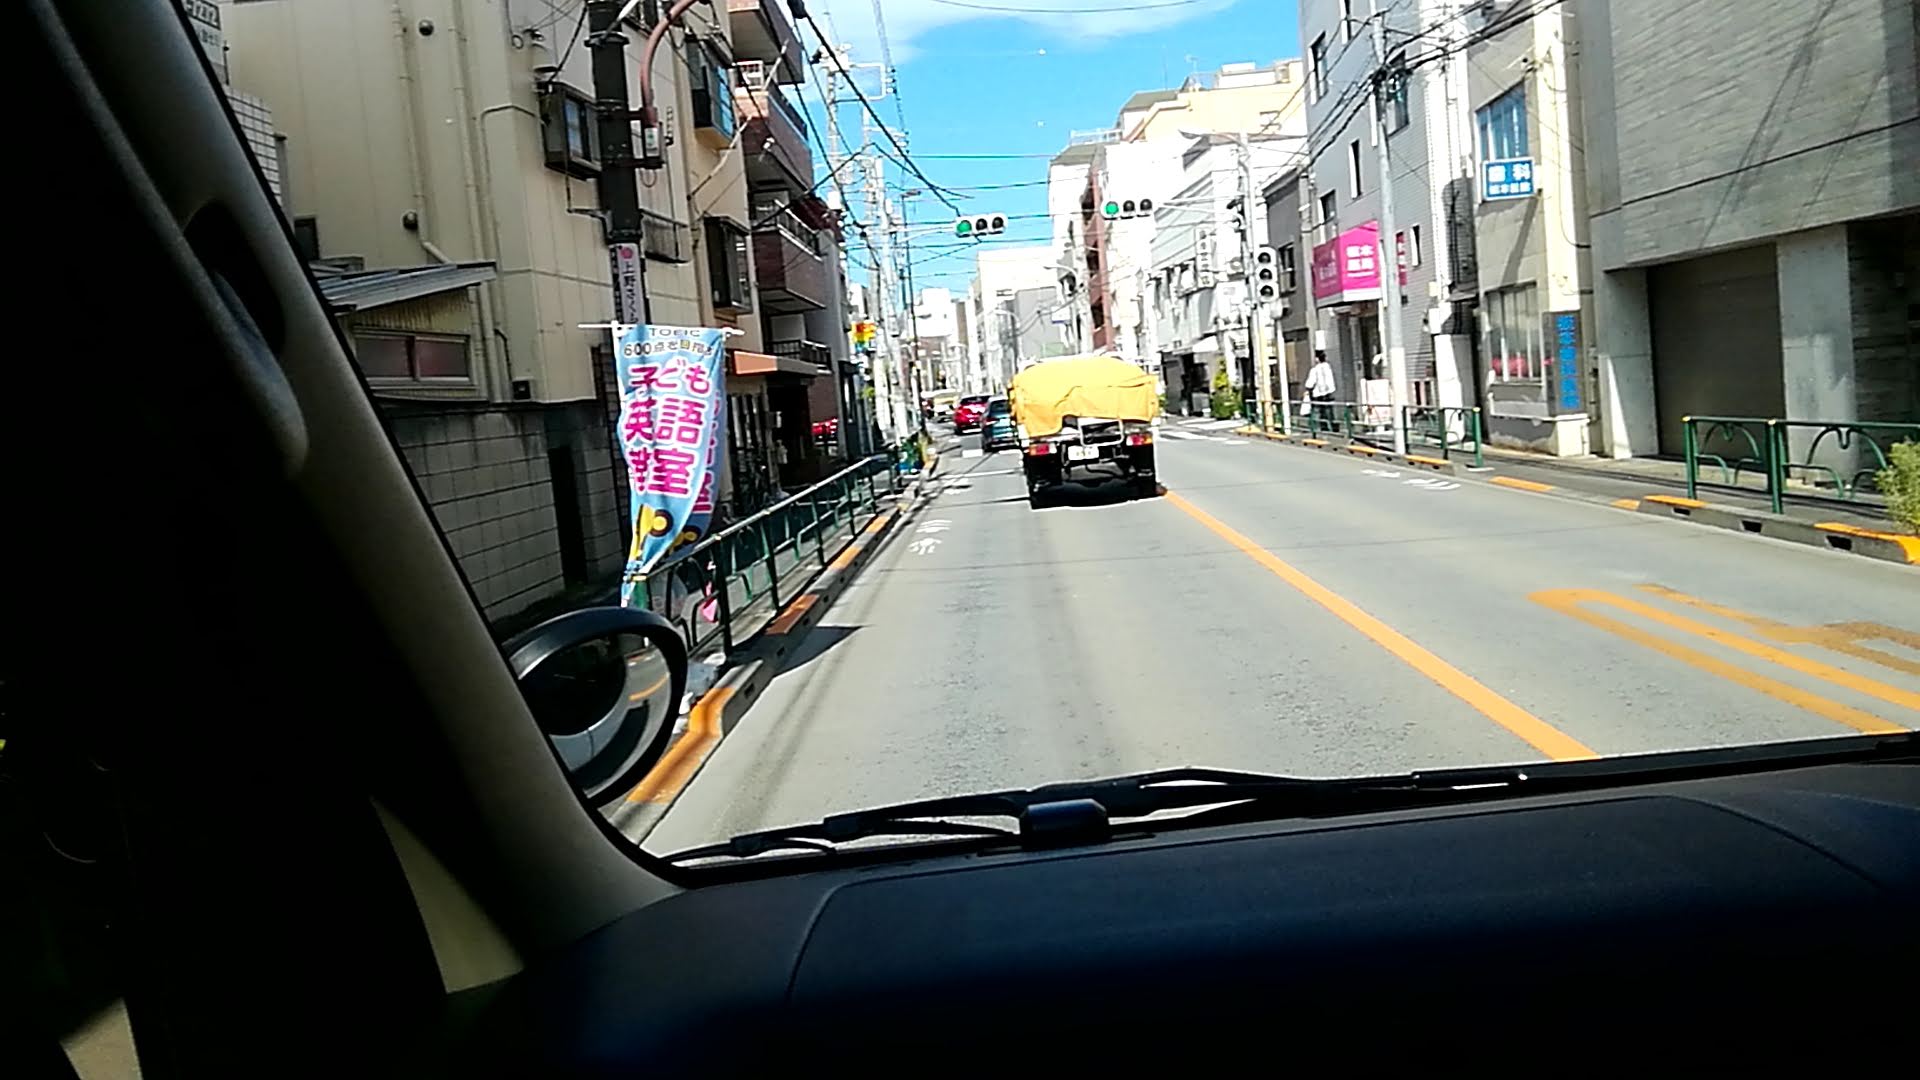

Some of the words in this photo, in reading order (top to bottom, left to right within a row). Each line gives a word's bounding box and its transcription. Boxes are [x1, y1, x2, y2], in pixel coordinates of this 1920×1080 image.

[650, 327, 701, 337] TOEIC
[631, 359, 710, 394] 子ども
[625, 397, 706, 445] 英語
